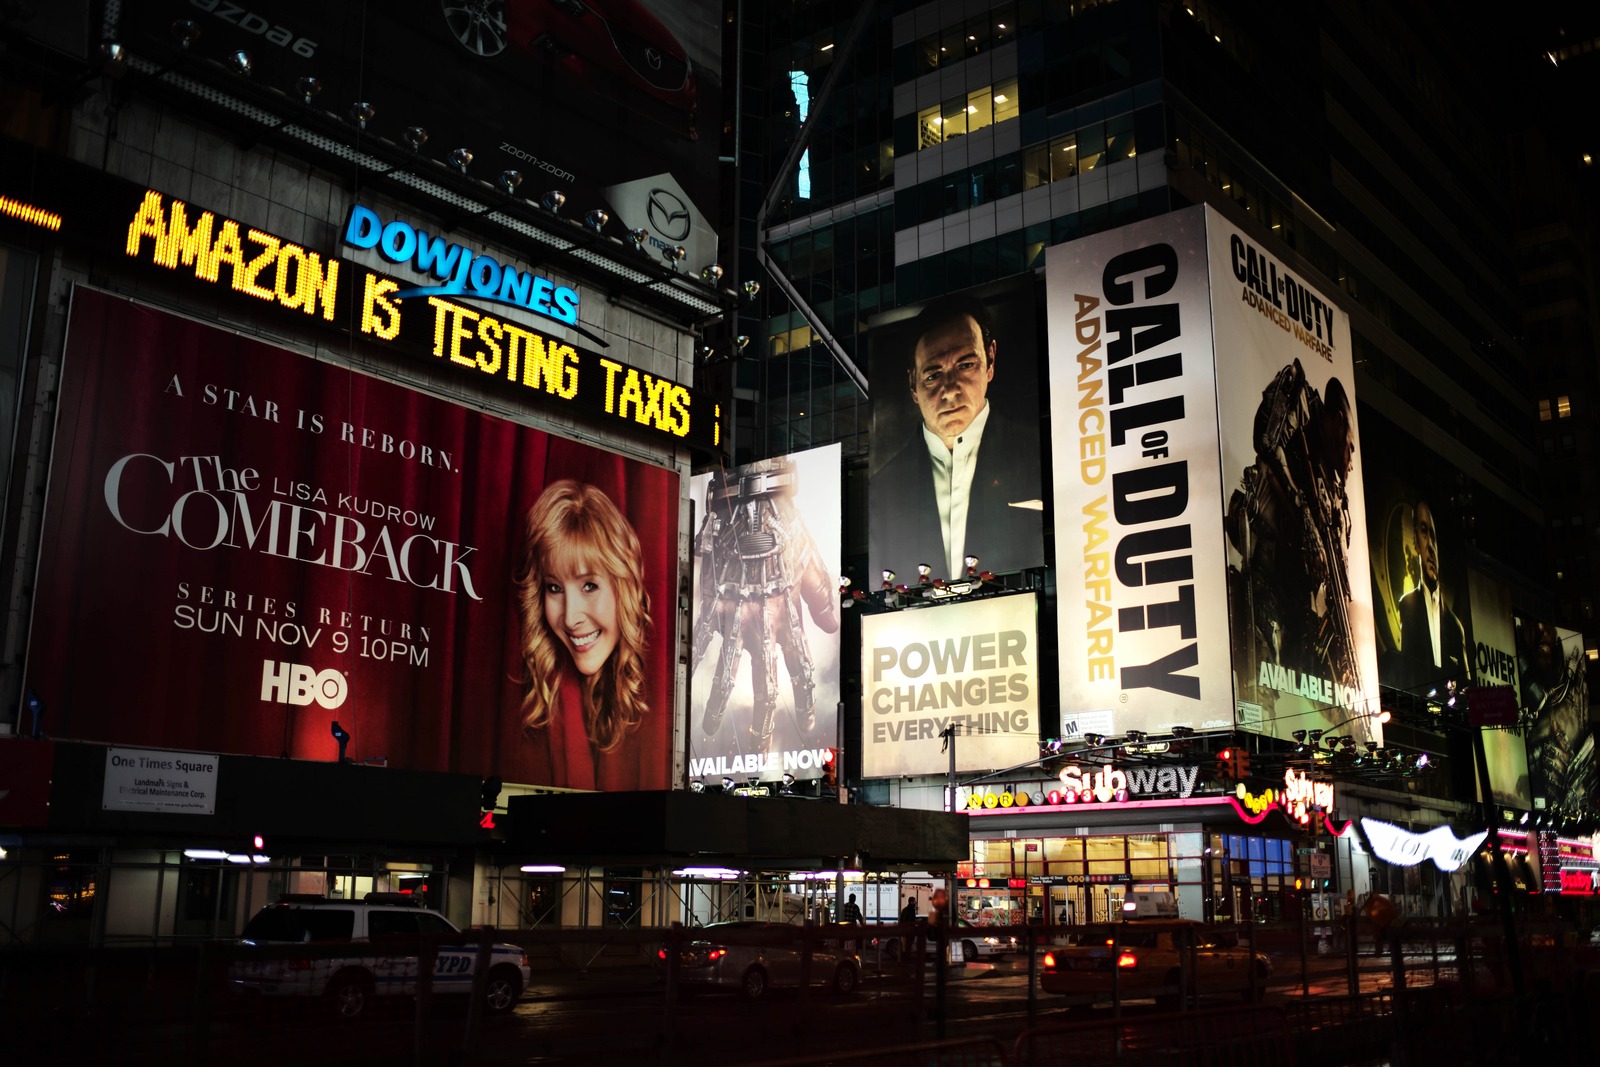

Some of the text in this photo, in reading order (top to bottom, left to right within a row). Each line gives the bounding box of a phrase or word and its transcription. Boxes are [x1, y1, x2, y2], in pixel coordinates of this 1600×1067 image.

[499, 141, 576, 184] zoom-zoom
[126, 189, 340, 322] AMAZON
[361, 272, 403, 342] IS
[428, 296, 580, 400] TESTING
[600, 358, 692, 438] TAXIS
[1230, 233, 1335, 348] CALL OF DUTY
[1102, 242, 1186, 448] CALL
[1241, 286, 1334, 364] ADVANCED WARFARE
[1074, 293, 1107, 486] ADVANCED
[163, 373, 460, 473] A STAR IS REBORN.
[1140, 428, 1169, 460] OF
[180, 455, 260, 494] The
[104, 453, 483, 601] COMEBACK
[273, 476, 436, 531] LISA KUDROW
[1081, 494, 1115, 683] WARFARE
[1112, 460, 1201, 701] DUTY
[173, 604, 430, 668] SUN NOV 9 10PM
[177, 581, 431, 643] SERIES RETURN
[873, 629, 1027, 683] POWER
[261, 659, 348, 710] HBO
[872, 672, 1030, 716] CHANGES
[1258, 660, 1333, 706] AVAILABLE
[873, 709, 1029, 744] EVERYTHING
[1065, 720, 1079, 735] M
[111, 755, 213, 773] One Times Square
[134, 778, 166, 788] Landmark
[166, 780, 182, 789] Signs
[783, 748, 825, 771] NOW
[1058, 764, 1199, 799] Subway
[148, 788, 190, 798] Maintenance
[190, 790, 206, 799] Corp.
[437, 956, 472, 973] YPD
